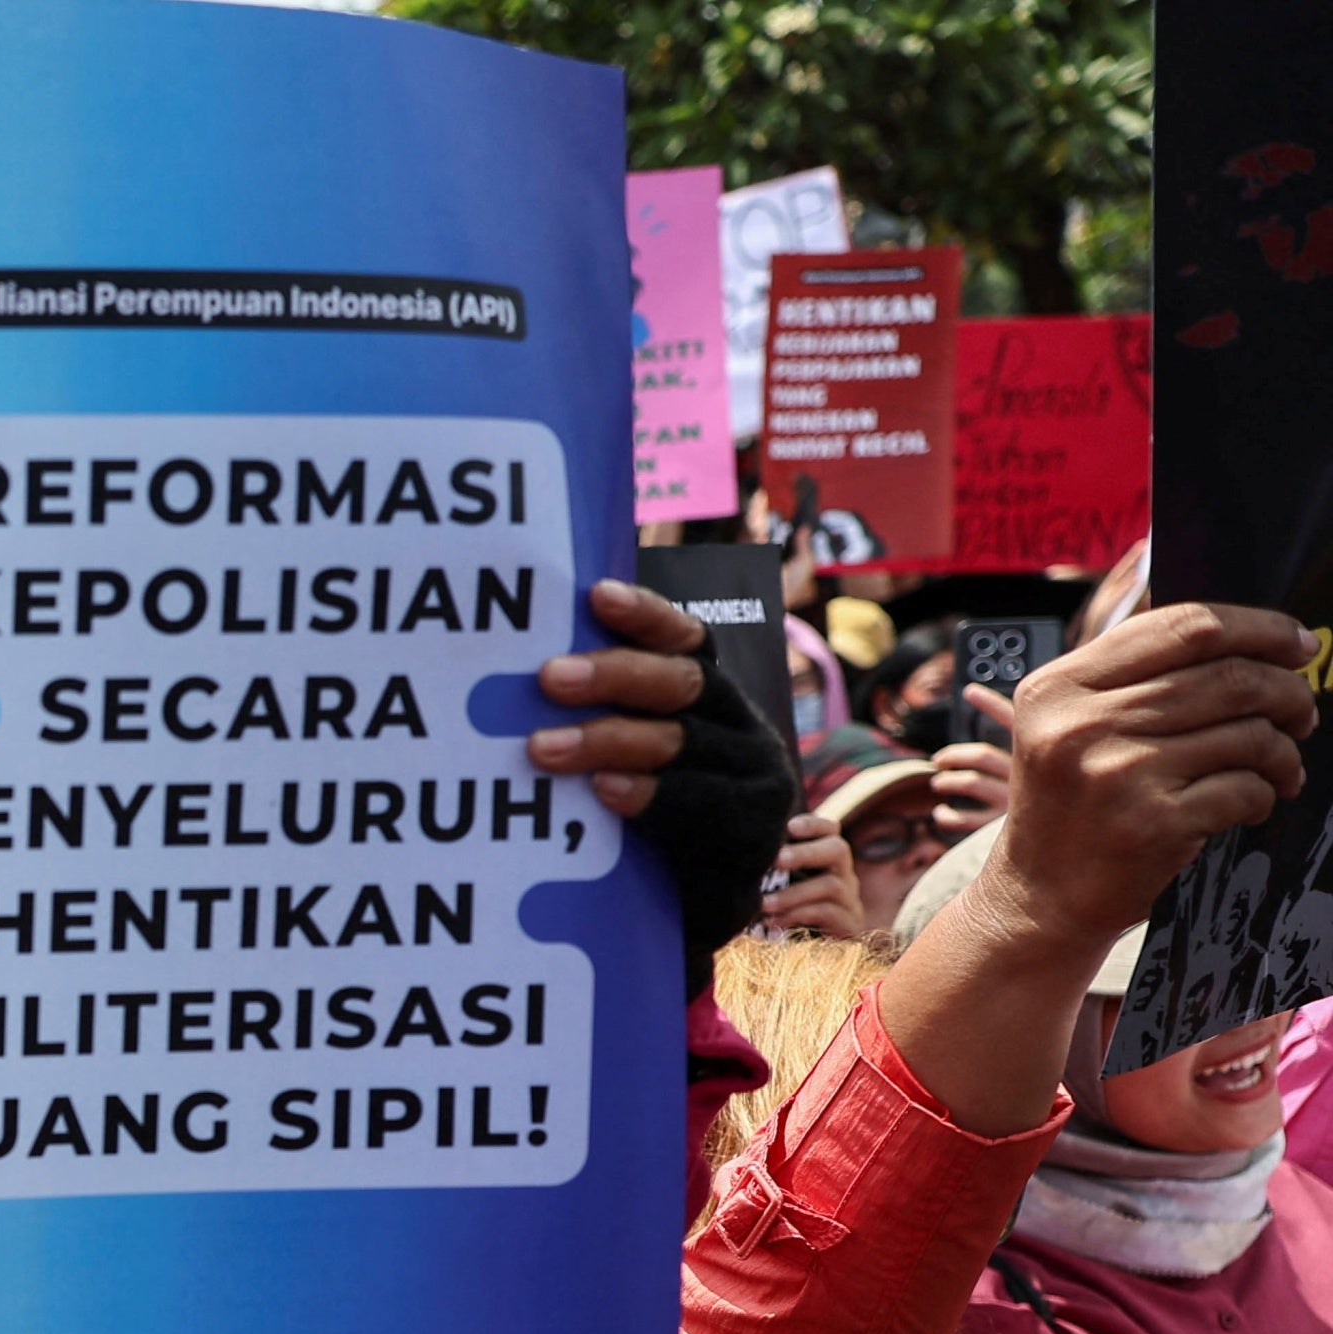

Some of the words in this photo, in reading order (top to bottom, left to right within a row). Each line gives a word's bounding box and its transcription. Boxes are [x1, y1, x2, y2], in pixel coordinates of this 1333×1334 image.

[93, 281, 284, 324] Perempuan
[290, 285, 444, 321] Indonesia
[448, 291, 517, 333] (API)
[39, 675, 428, 744] SECARA
[268, 1085, 551, 1153] SIPIL!
